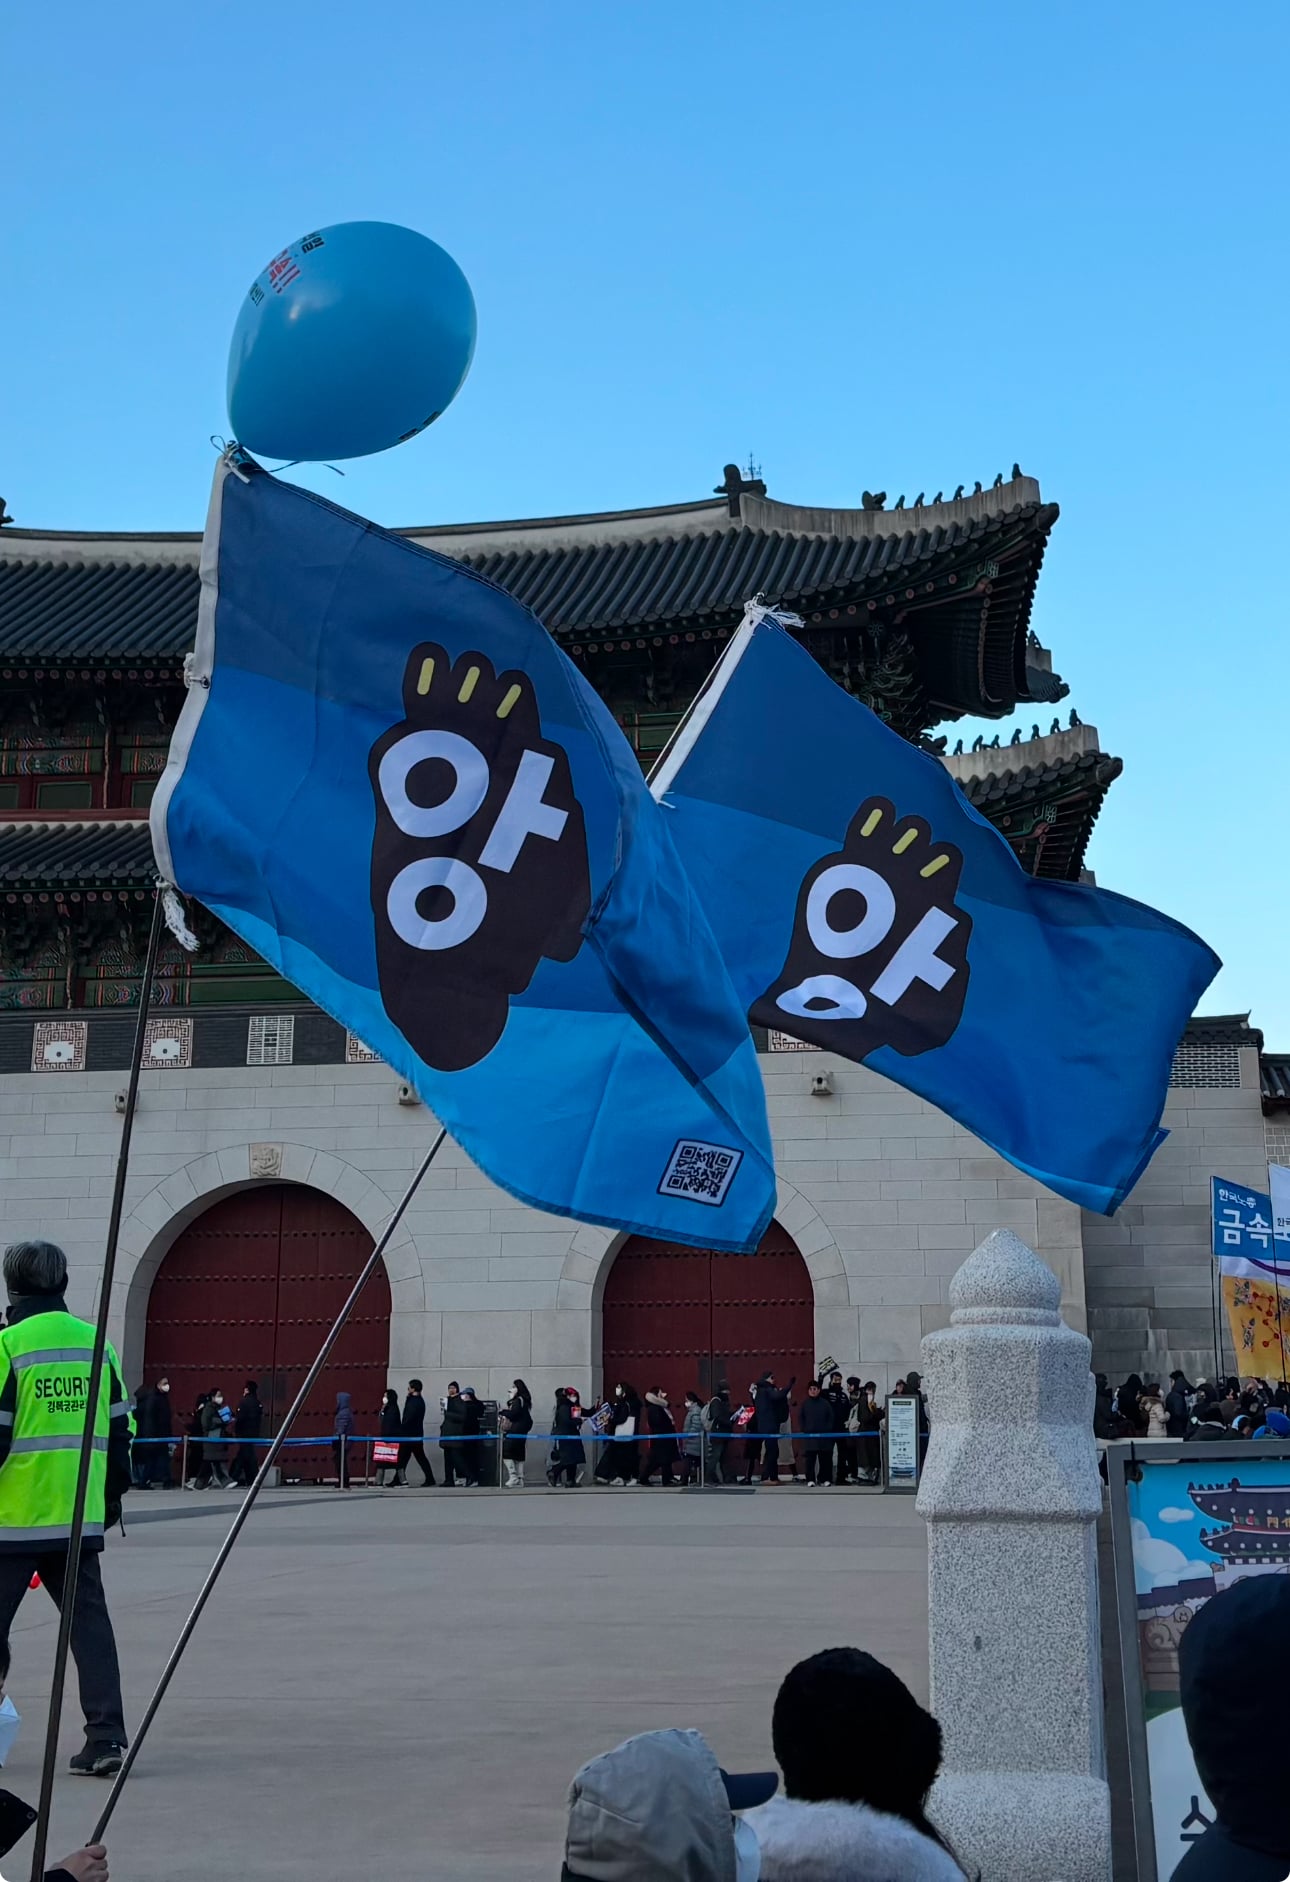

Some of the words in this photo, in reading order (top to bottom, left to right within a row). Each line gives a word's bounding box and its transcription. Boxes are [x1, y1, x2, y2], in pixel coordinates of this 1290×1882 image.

[377, 729, 569, 951] 앙
[775, 863, 959, 1020] 앙
[1218, 1208, 1290, 1249] 금속
